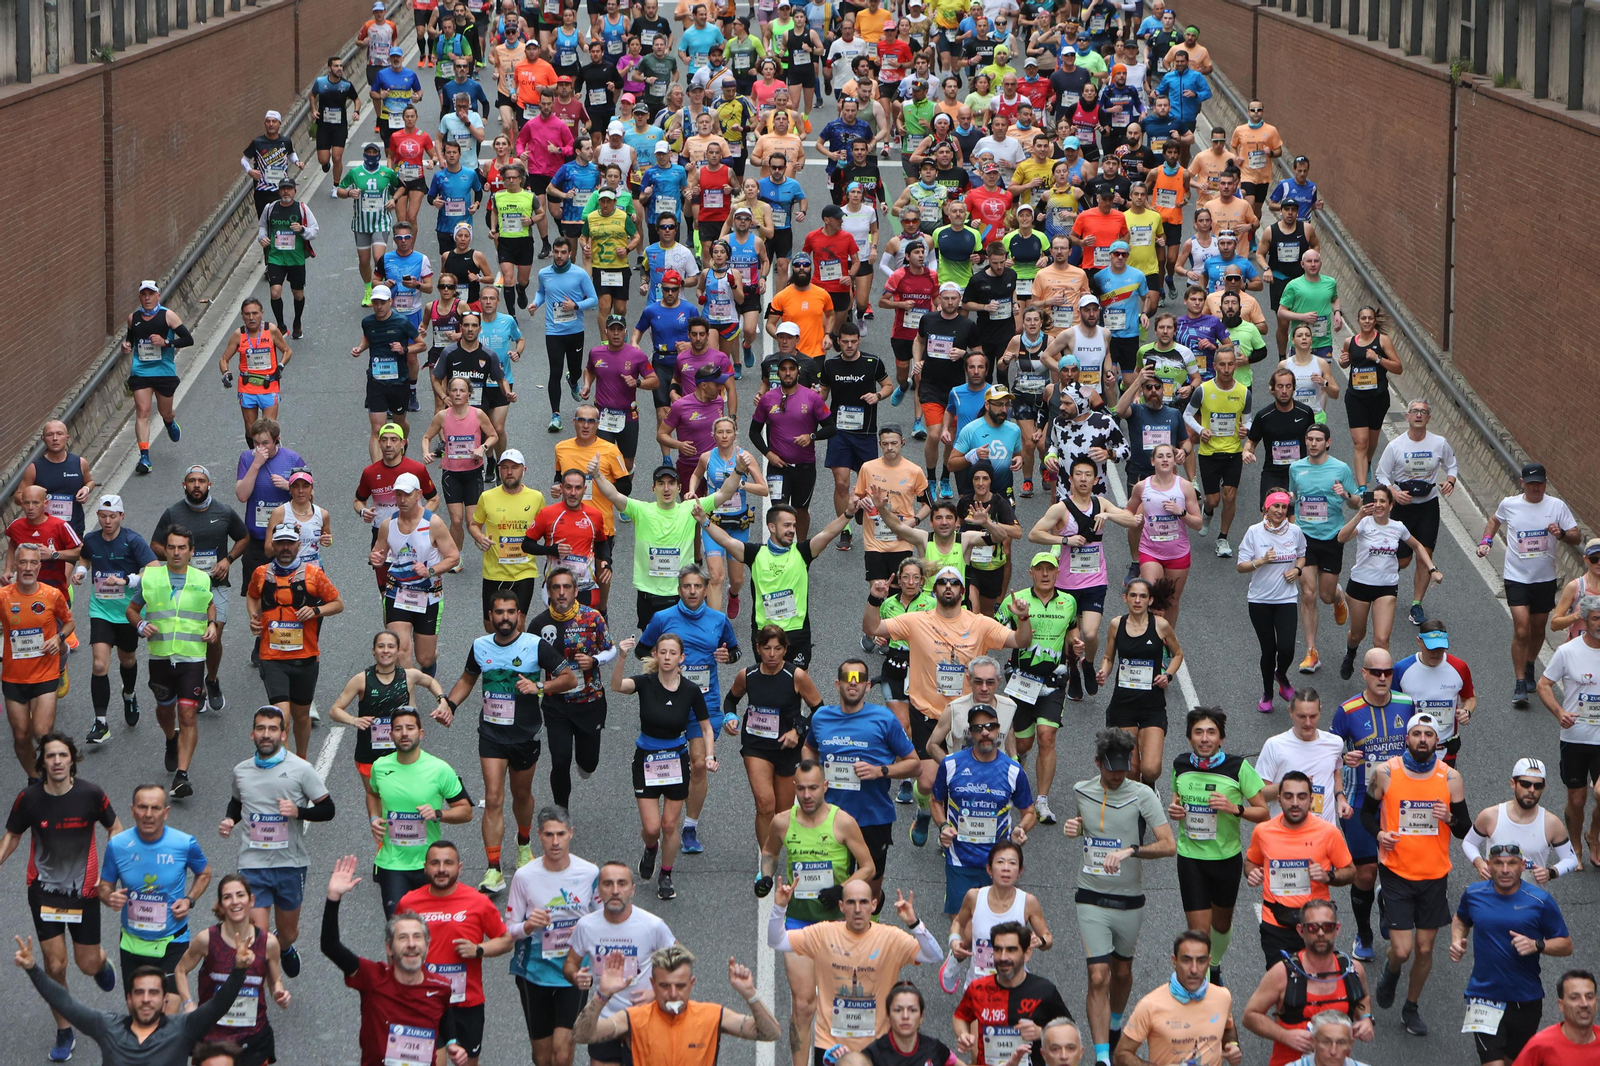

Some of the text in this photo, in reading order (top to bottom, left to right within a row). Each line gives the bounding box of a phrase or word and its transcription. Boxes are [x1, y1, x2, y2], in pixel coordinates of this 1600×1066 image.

[453, 370, 484, 379] Playtika
[156, 854, 174, 864] ITA
[140, 894, 164, 902] ZURICH
[438, 964, 462, 972] ZURICH
[982, 1008, 1006, 1021] 42,195
[406, 1029, 432, 1037] ZURICH
